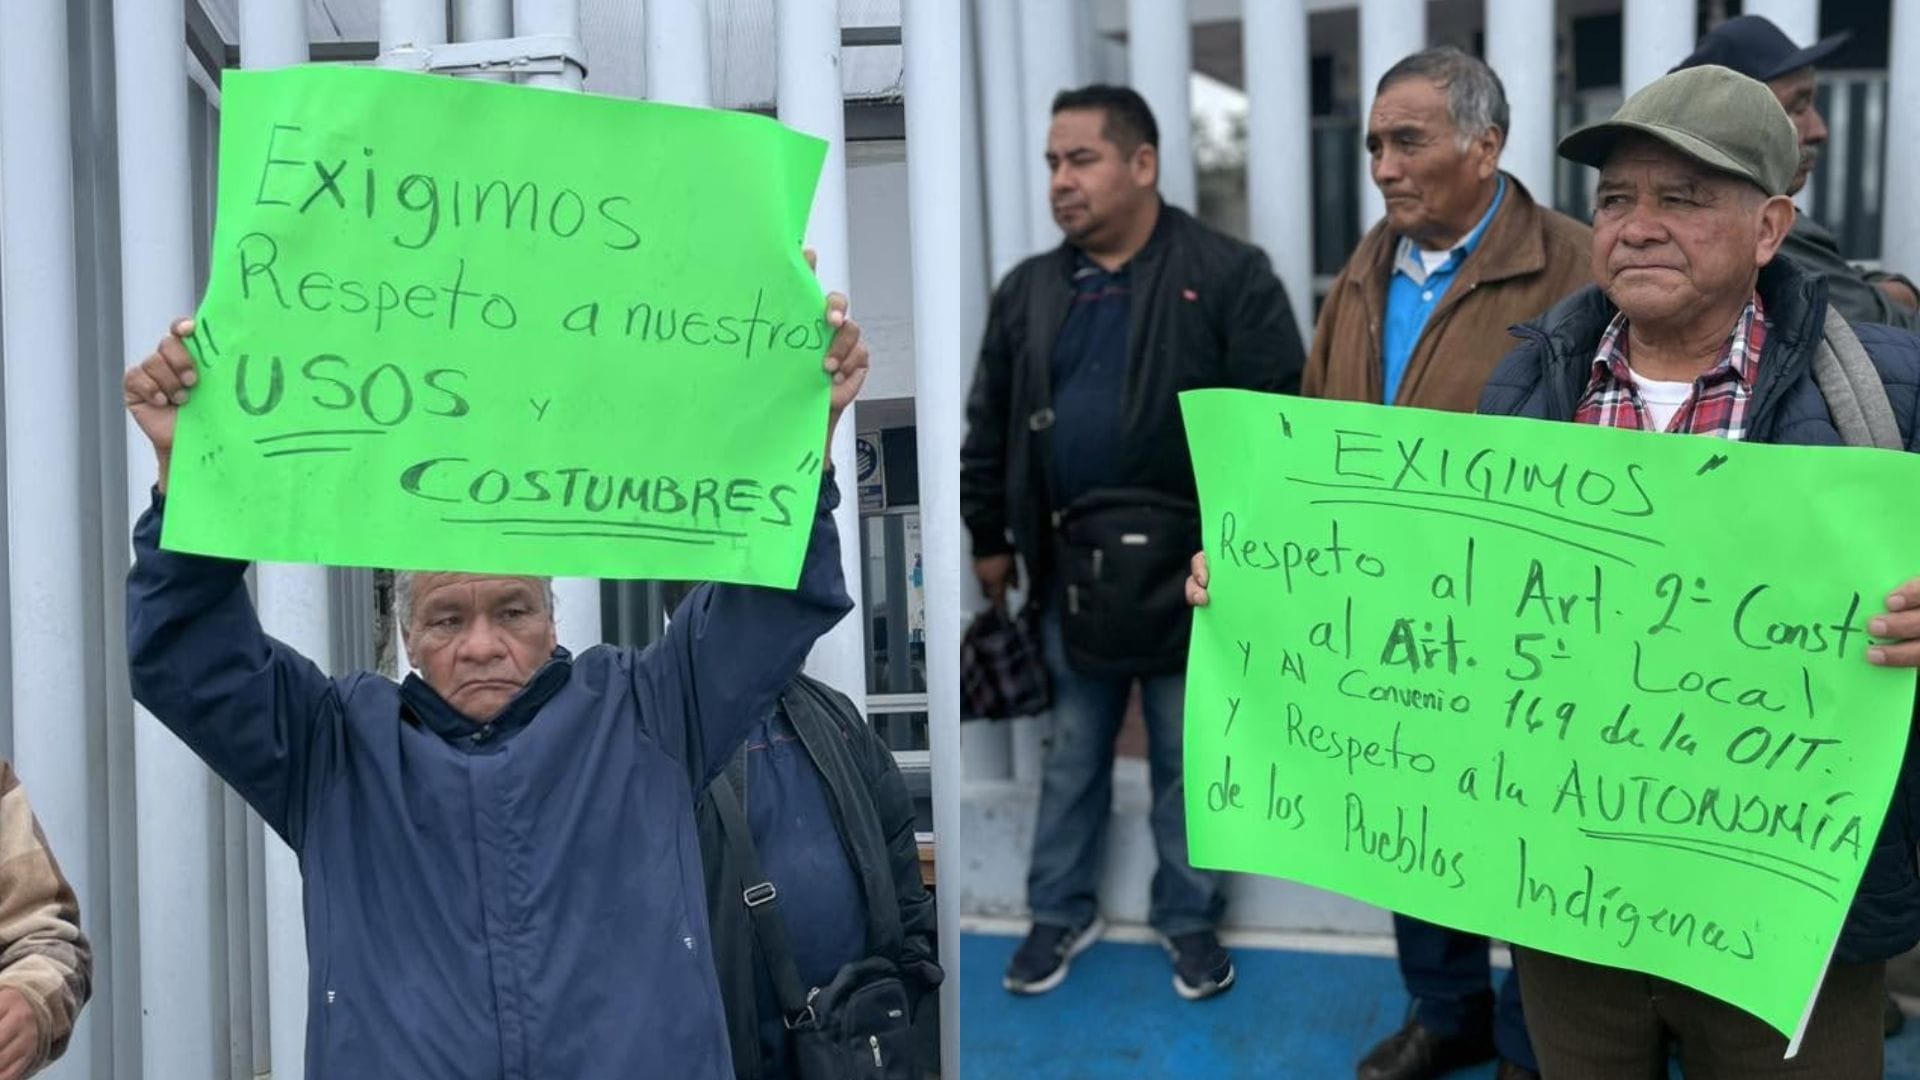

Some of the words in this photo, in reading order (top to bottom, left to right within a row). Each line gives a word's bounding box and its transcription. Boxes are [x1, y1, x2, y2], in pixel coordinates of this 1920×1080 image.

[256, 123, 642, 252] Exigimos
[237, 232, 518, 333] Respeto
[562, 301, 599, 336] a
[625, 288, 824, 358] nuestros
[1219, 510, 1386, 595] Respeto
[1431, 536, 1475, 607] al
[1514, 558, 1624, 634] Art.
[1308, 595, 1352, 660] al
[1632, 640, 1816, 720] Local
[1336, 668, 1472, 713] Convenio
[1504, 688, 1577, 741] 169
[1600, 703, 1645, 748] de
[1658, 711, 1698, 756] la
[1285, 701, 1436, 776] Respeto
[1206, 754, 1246, 813] de
[1266, 761, 1306, 830] los
[1344, 792, 1466, 890] Pueblos
[1515, 835, 1755, 960] Indígenas
